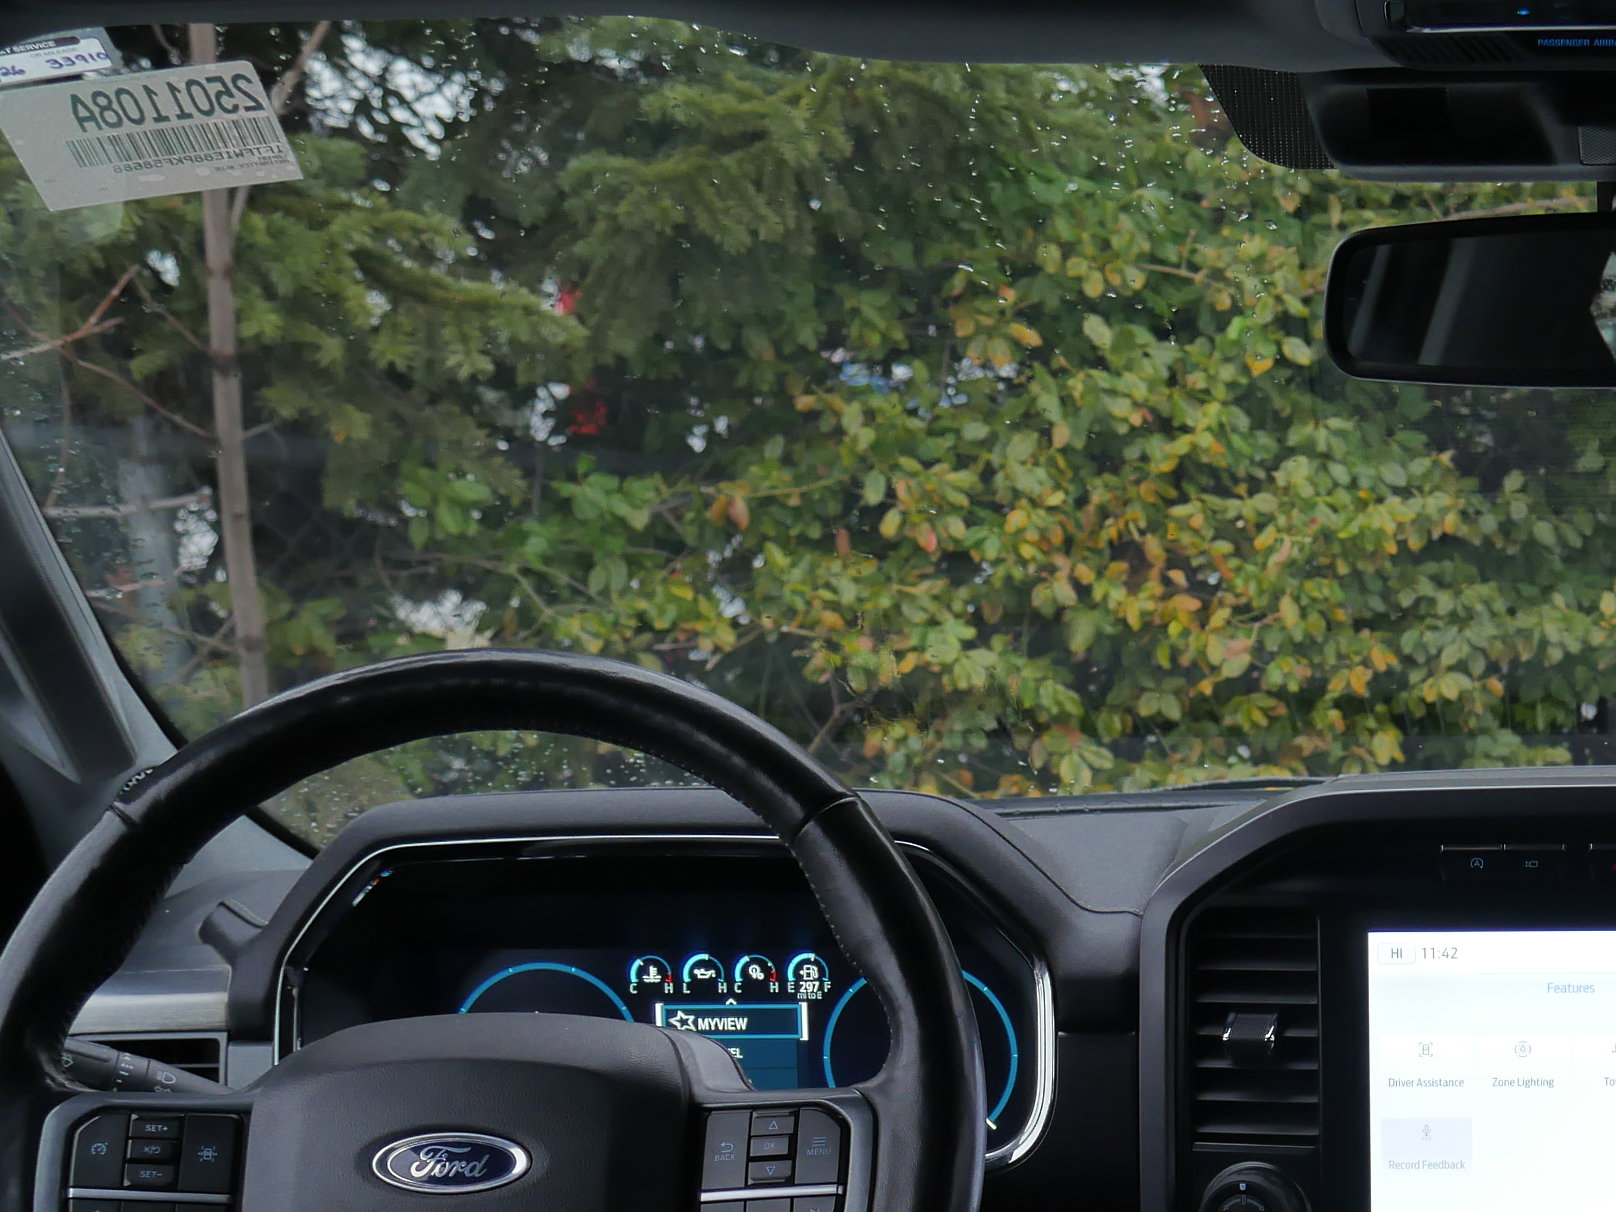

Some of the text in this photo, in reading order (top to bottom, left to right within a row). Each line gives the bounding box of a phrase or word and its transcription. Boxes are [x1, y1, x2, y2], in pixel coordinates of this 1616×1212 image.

[12, 40, 56, 53] SERVICE
[1537, 38, 1590, 47] PASSENGER
[1391, 947, 1403, 960] HI
[1420, 946, 1458, 960] 11:42
[630, 983, 637, 994] C
[665, 983, 674, 993] H
[683, 983, 691, 993] L
[718, 983, 727, 993] H
[734, 983, 742, 993] C
[770, 983, 779, 993] H
[788, 983, 795, 993] E
[799, 981, 819, 993] 297
[824, 982, 832, 993] F
[1547, 981, 1596, 994] Features
[697, 1017, 748, 1031] MYVIEW
[1388, 1076, 1465, 1088] Driver Assistance
[1491, 1076, 1554, 1089] Zone Lighting
[714, 1153, 735, 1162] BACK
[806, 1147, 832, 1157] MENU
[410, 1145, 490, 1178] Ford
[1388, 1159, 1466, 1171] Record Feedback
